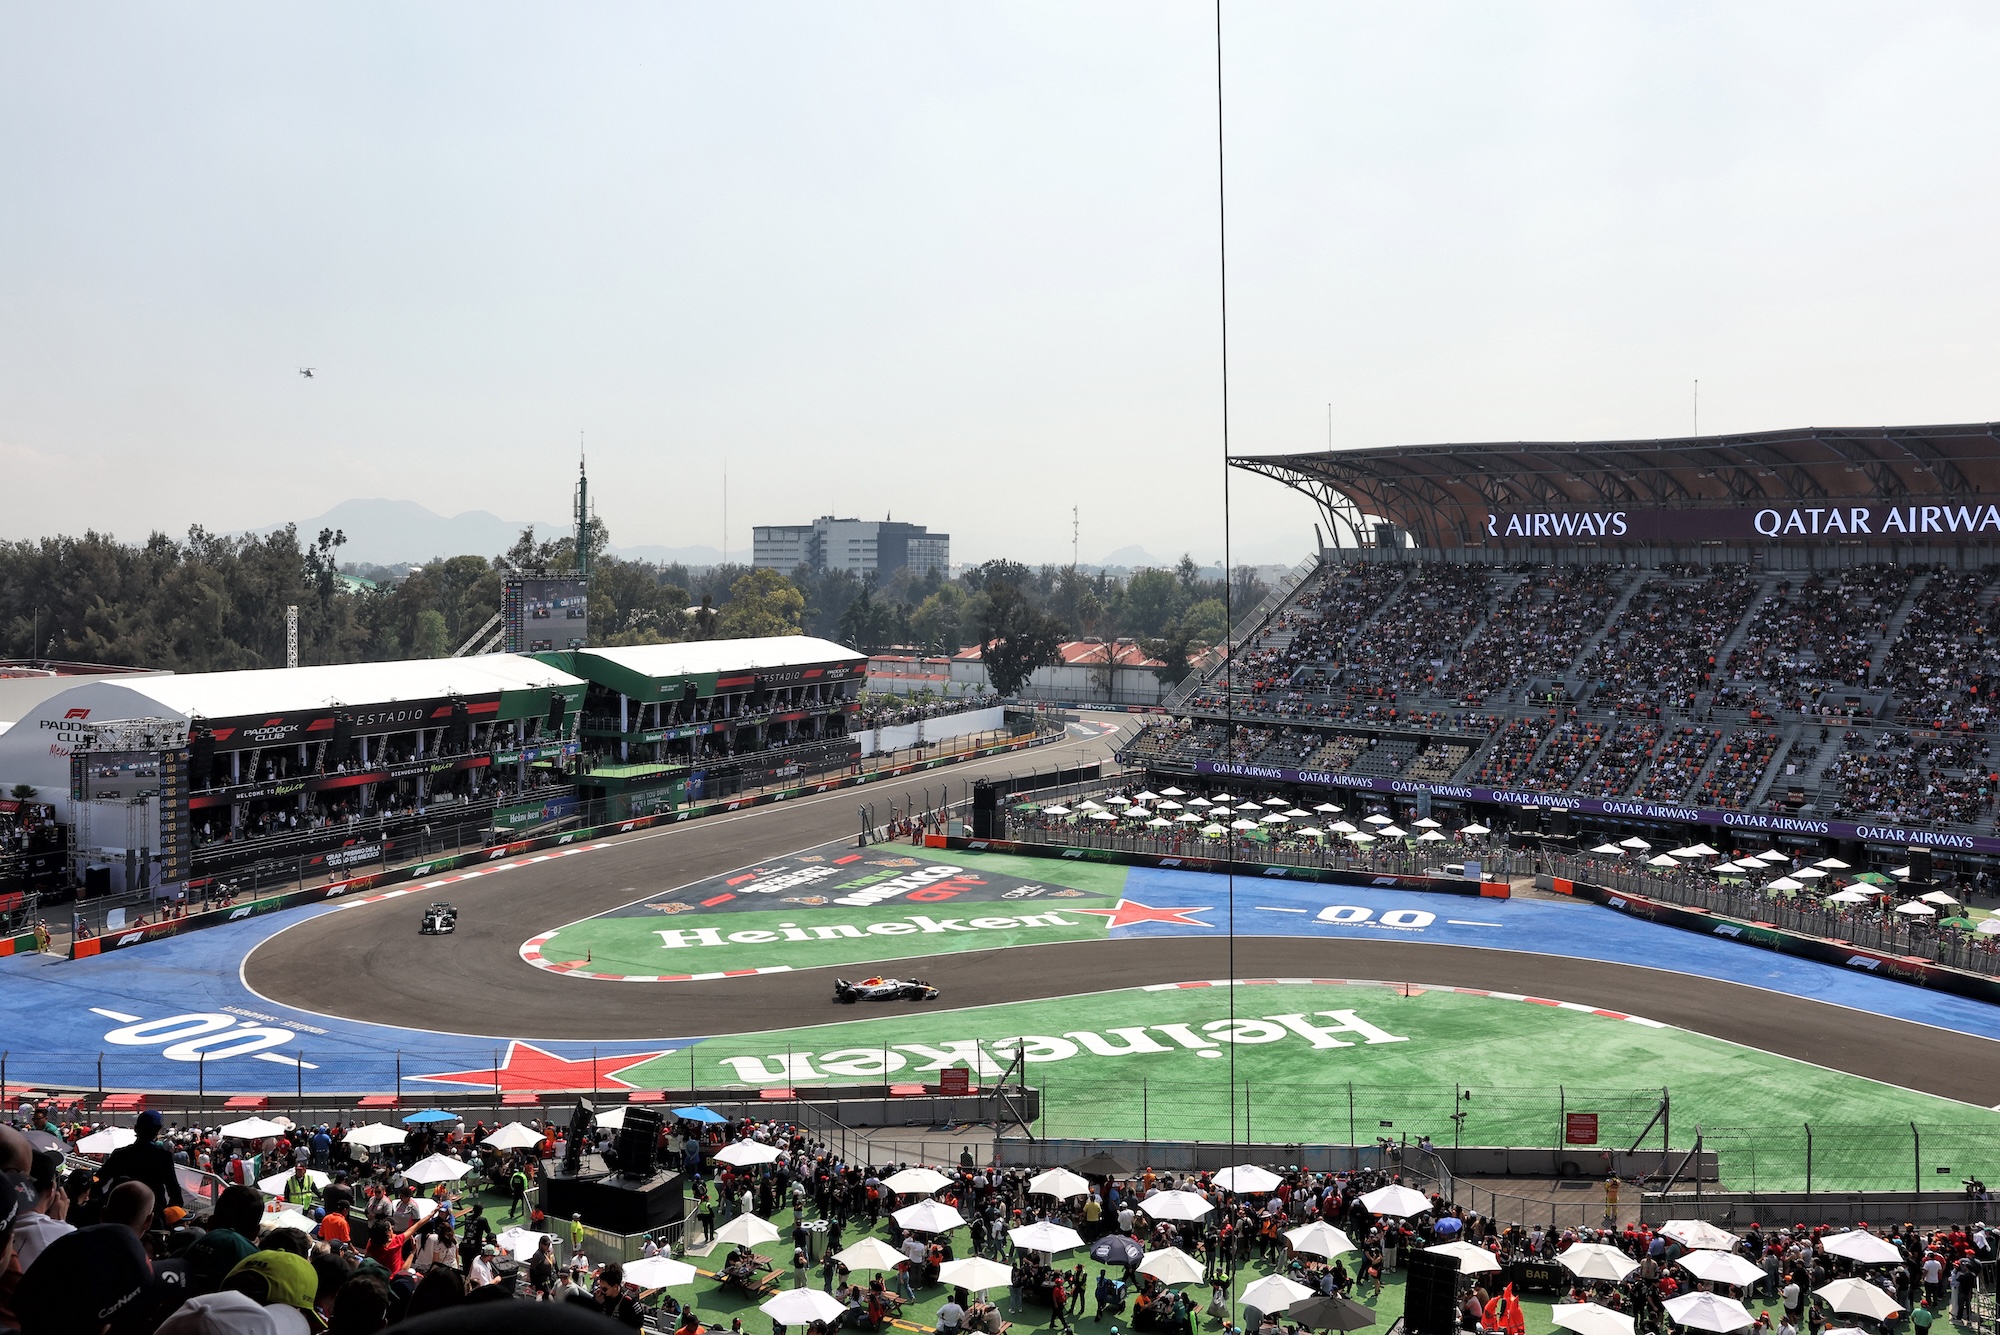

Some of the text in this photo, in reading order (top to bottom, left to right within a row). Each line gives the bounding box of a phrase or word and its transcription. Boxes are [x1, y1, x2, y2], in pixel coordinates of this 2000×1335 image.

[1504, 512, 1628, 537] AIRWAYS
[1754, 504, 2000, 539] QATAR AIRWA
[764, 672, 800, 682] ESTADIO
[1076, 702, 1116, 711] allwyn
[356, 709, 423, 726] ESTADIO
[243, 724, 299, 736] PADDOCK
[254, 732, 286, 742] CLUB
[165, 752, 174, 763] 20
[498, 754, 518, 763] Heineken
[391, 769, 424, 778] BIENVENIDO
[1212, 762, 1242, 776] QATAR
[1244, 766, 1282, 779] AIRWAYS
[1298, 772, 1373, 788] QATAR AIRWAYS
[236, 790, 264, 799] WELCOME
[274, 782, 306, 796] Mexico
[646, 791, 656, 799] YOU
[656, 788, 670, 796] DRIVE
[1429, 784, 1472, 798] AIRWAYS
[1492, 790, 1580, 809] QATAR AIRWAYS
[510, 810, 540, 824] Heinken
[1602, 802, 1698, 820] QATAR AIRWAYS
[1723, 813, 1829, 834] QATAR AIRWAYS
[167, 835, 176, 844] LEC
[1856, 826, 1974, 848] QATAR AIRWAYS
[968, 841, 990, 850] F1
[343, 848, 366, 858] PREMIO
[489, 848, 506, 859] F1
[1061, 850, 1084, 858] F1
[167, 858, 176, 867] ALB
[1159, 858, 1182, 867] F1
[167, 869, 178, 878] ANT
[412, 865, 432, 877] F1
[1262, 868, 1288, 877] F1
[832, 870, 904, 890] THIS IS
[833, 865, 964, 906] MEXICO
[1372, 876, 1398, 886] F1
[325, 884, 348, 897] F1
[905, 874, 989, 901] CITY
[1608, 896, 1628, 909] F1
[228, 906, 252, 920] F1
[1316, 904, 1437, 928] 0.0
[652, 913, 1080, 949] Heineken
[1712, 923, 1782, 950] F1 Mexico City
[116, 931, 144, 946] F1
[1846, 955, 1928, 986] F1 Mexico City
[103, 1012, 296, 1062] 0.0
[718, 1008, 1411, 1085] Heineken
[246, 1260, 268, 1268] BOSS
[1526, 1270, 1548, 1280] BAR
[98, 1286, 142, 1319] CarNext
